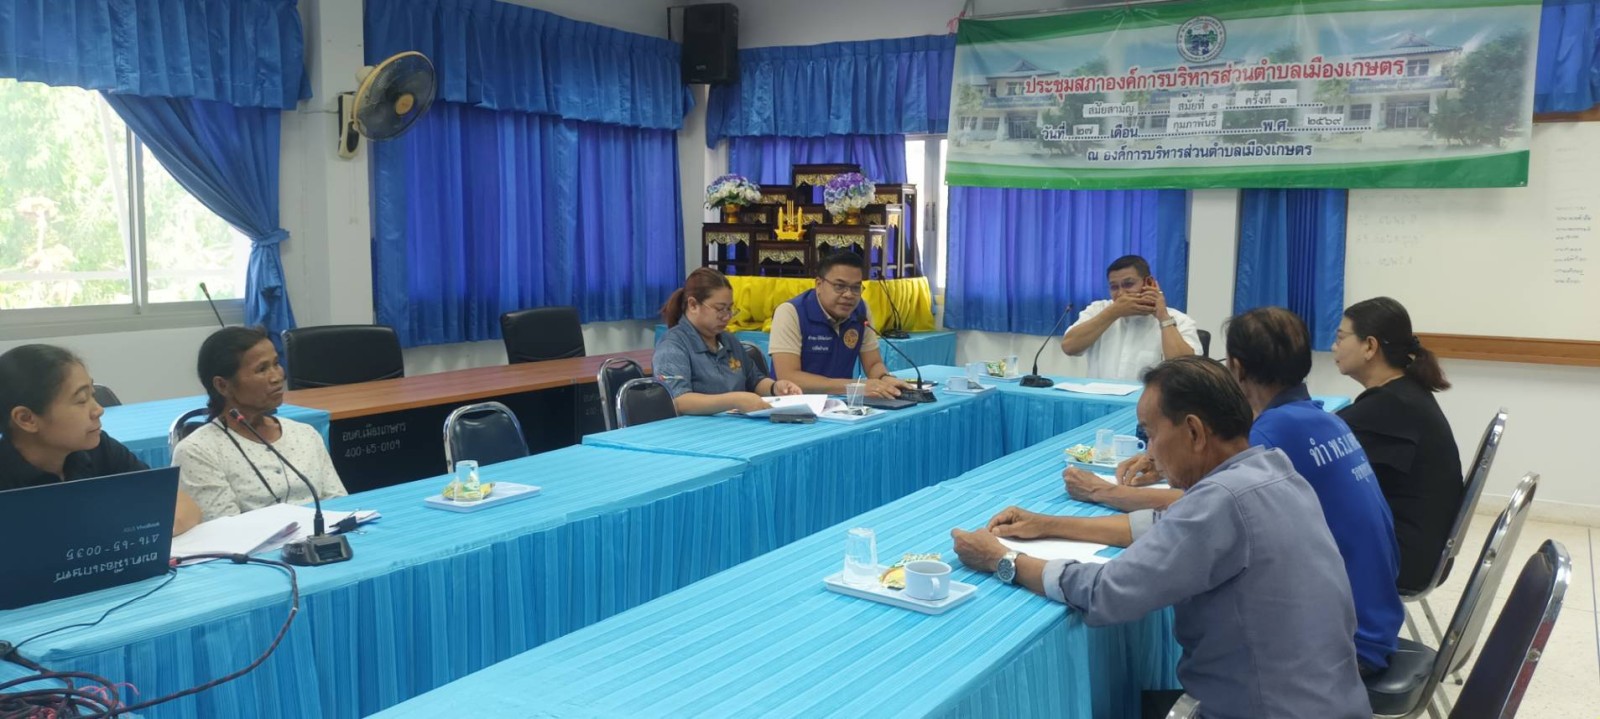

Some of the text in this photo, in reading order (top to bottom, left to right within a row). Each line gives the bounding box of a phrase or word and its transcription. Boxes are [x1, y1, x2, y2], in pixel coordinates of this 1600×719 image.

[1025, 57, 1405, 99] ประชุมสภาองค์การบริหารส่วนตำบลเมืองเกษตร
[1088, 102, 1135, 117] สมัยสามัญ
[1173, 115, 1217, 132] กุมภาพันธ์
[1087, 141, 1313, 161] ณ องค์การบริหารส่วนตำบลเมืองเกษตร
